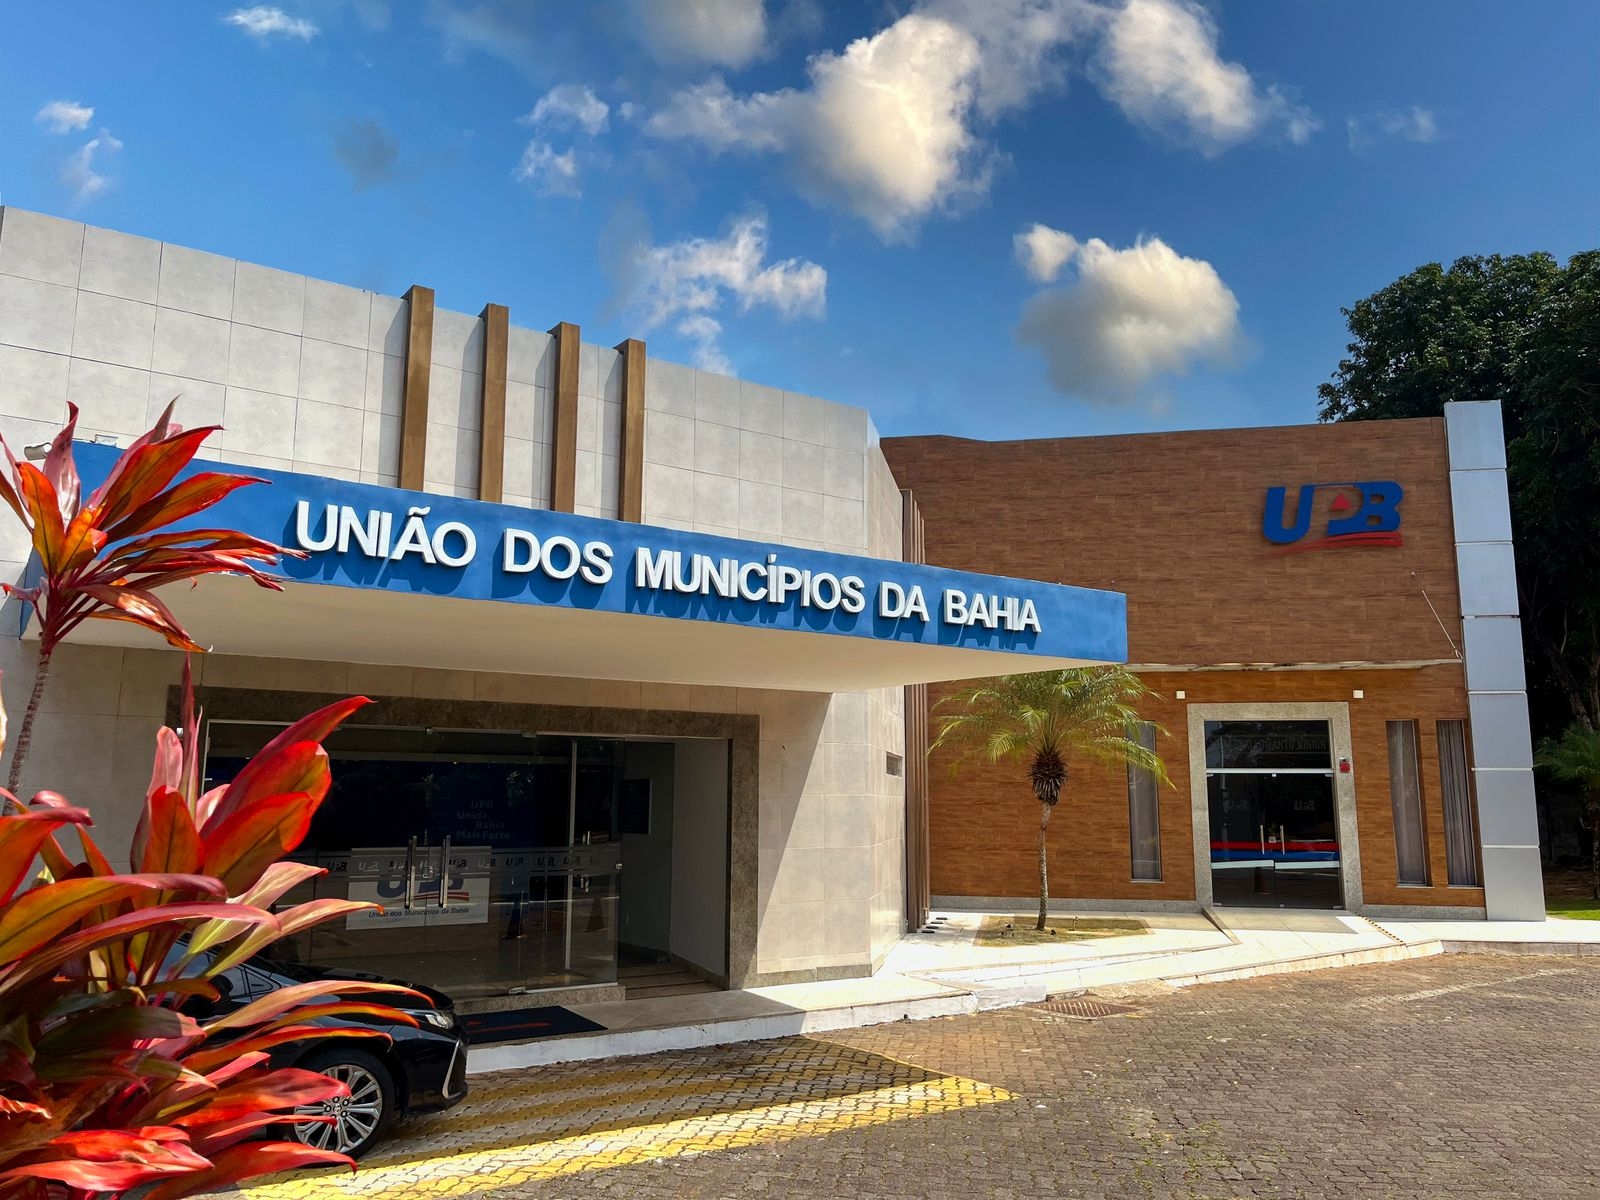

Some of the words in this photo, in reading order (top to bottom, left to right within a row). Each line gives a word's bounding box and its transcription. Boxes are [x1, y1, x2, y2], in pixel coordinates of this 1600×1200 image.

[1263, 481, 1402, 545] UPB
[296, 500, 476, 567] UNIÃO
[503, 528, 613, 584] DOS
[635, 546, 865, 613] MUNICÍPIOS
[879, 581, 930, 622] DA
[943, 588, 1041, 633] BAHIA
[369, 910, 389, 918] Unio
